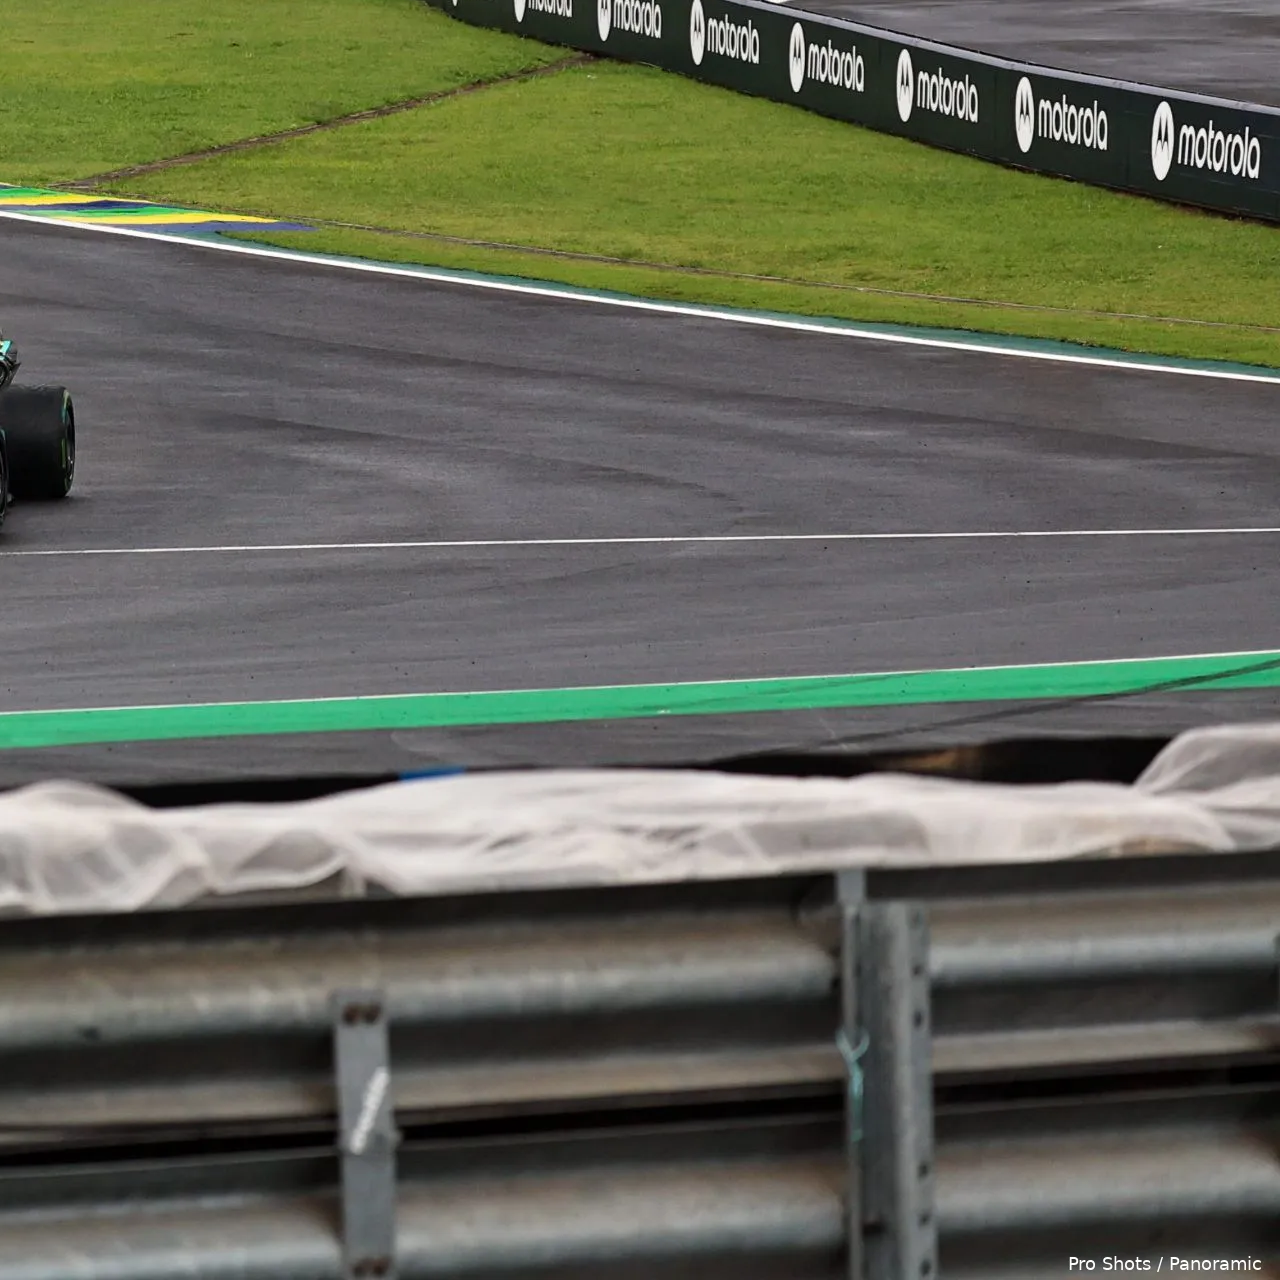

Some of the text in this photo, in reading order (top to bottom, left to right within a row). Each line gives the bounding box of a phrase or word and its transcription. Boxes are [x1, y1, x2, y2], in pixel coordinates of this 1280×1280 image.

[708, 14, 759, 63] motorola
[808, 40, 864, 91] motorola
[917, 68, 978, 122] motorola
[1039, 95, 1107, 150] motorola
[1178, 120, 1260, 178] motorola
